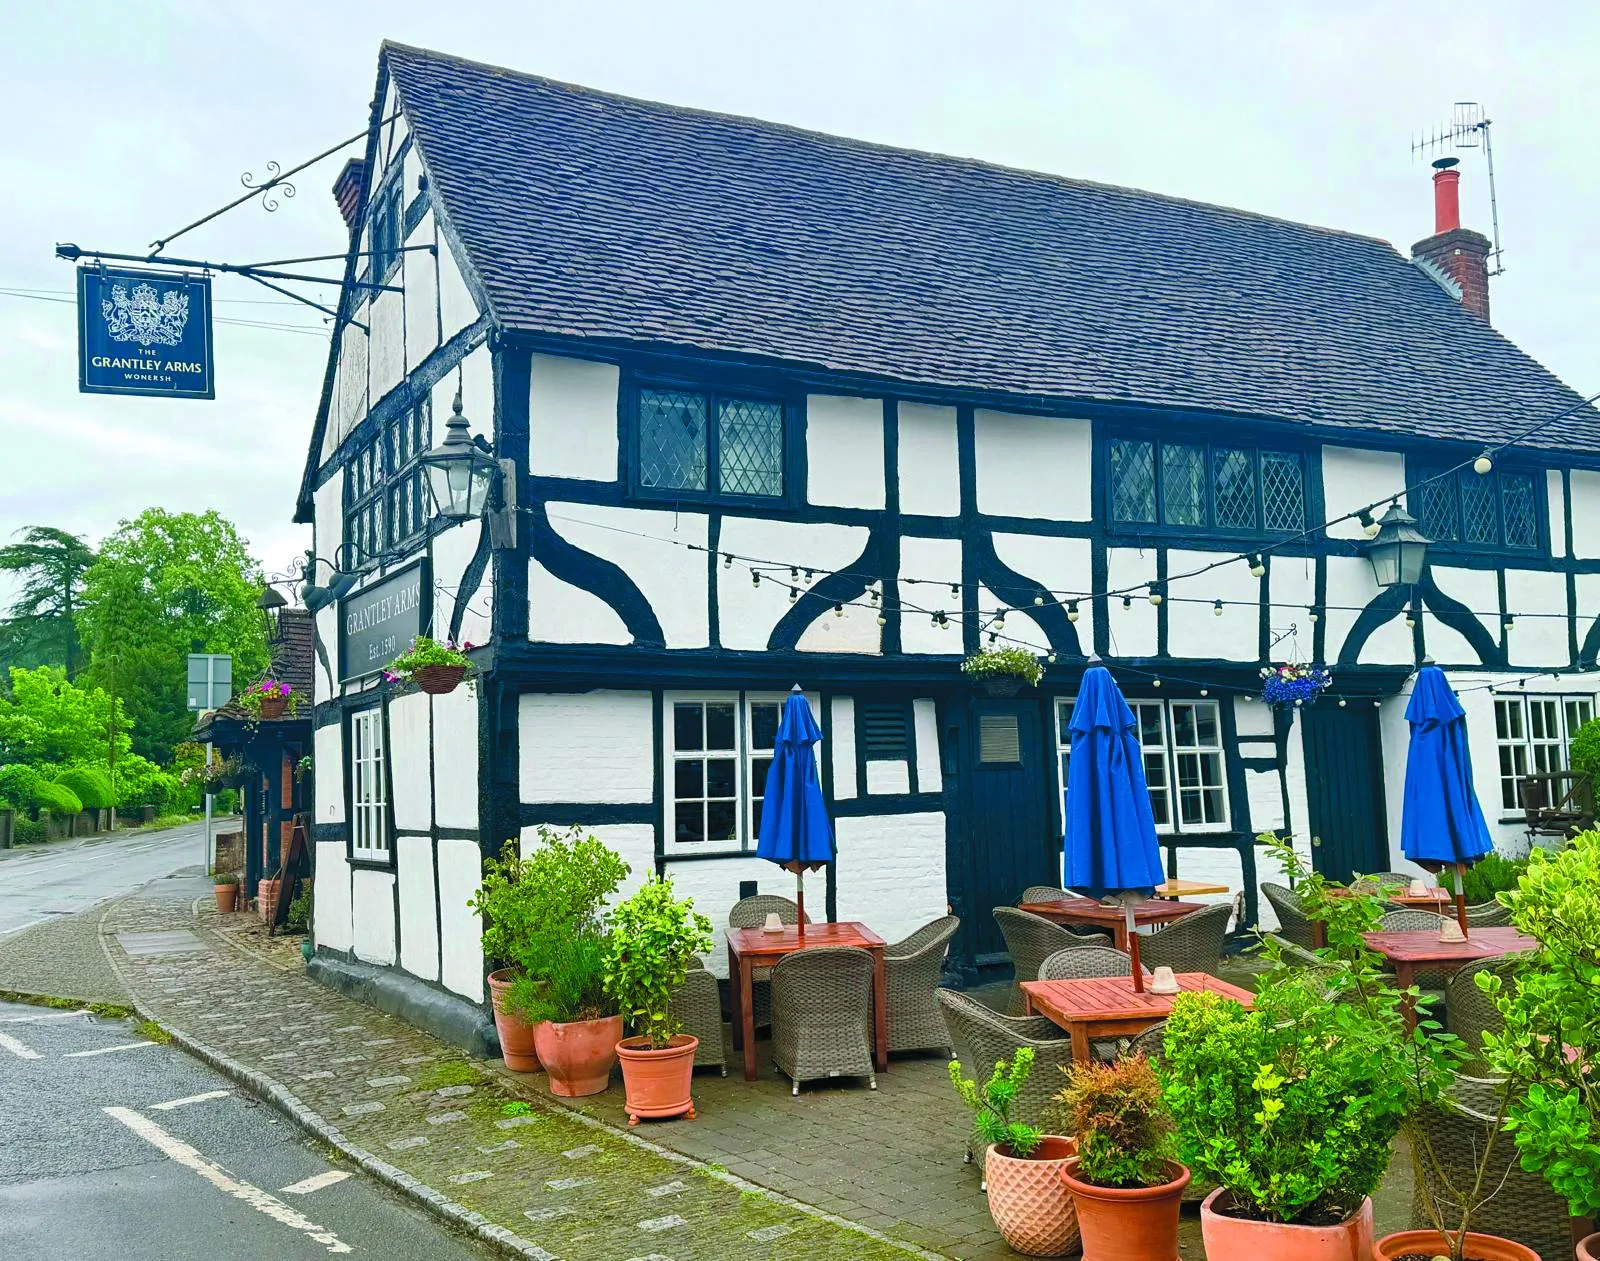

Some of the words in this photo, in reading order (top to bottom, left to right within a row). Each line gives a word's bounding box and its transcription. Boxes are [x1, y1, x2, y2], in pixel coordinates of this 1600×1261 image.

[138, 348, 157, 356] THE
[91, 356, 161, 371] GRANTLEY
[164, 361, 202, 373] ARMS
[124, 373, 171, 382] WONERSH
[346, 596, 392, 636] GRANTLEY
[394, 582, 420, 616] ARMS
